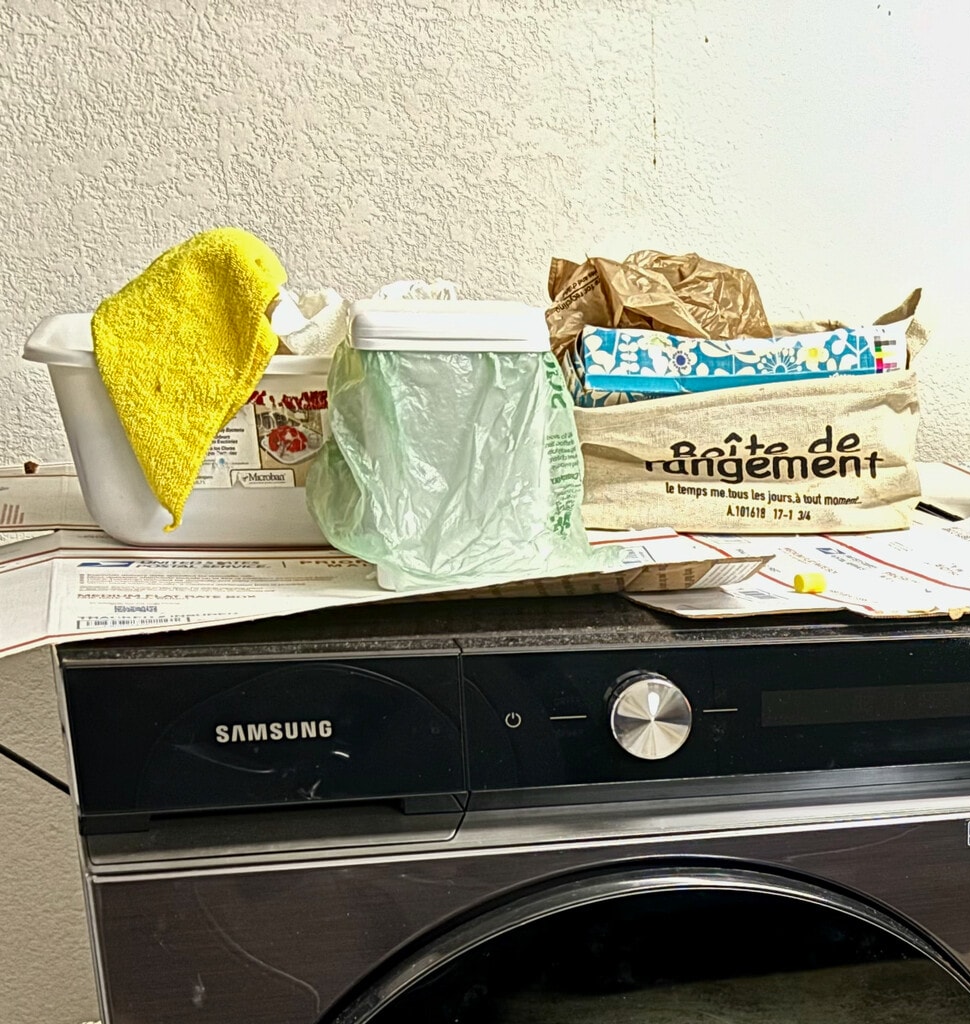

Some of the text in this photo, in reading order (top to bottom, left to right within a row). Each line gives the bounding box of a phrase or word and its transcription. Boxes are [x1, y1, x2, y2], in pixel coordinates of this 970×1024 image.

[808, 425, 861, 454] de
[248, 472, 286, 481] Microban
[645, 451, 884, 484] rangement
[666, 482, 674, 494] le
[678, 483, 708, 499] temps
[751, 489, 765, 501] les
[803, 494, 822, 505] tout
[773, 508, 793, 520] 17-1
[215, 720, 333, 743] SAMSUNG
